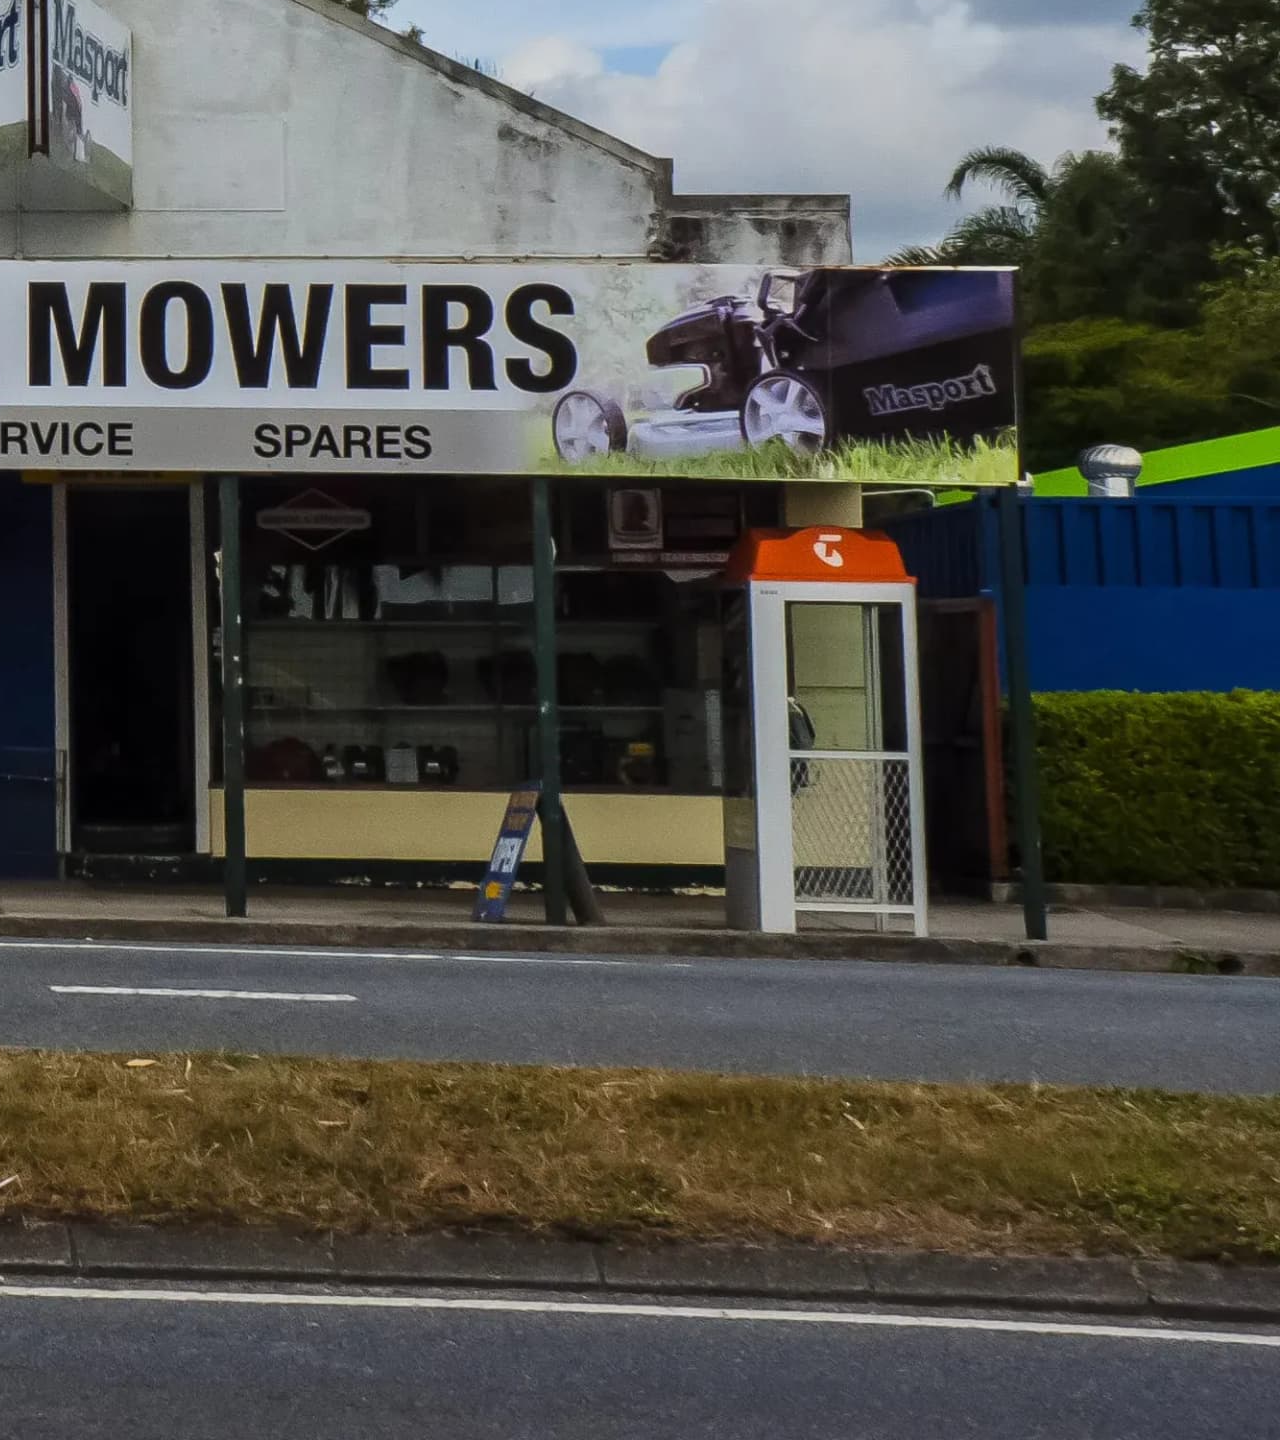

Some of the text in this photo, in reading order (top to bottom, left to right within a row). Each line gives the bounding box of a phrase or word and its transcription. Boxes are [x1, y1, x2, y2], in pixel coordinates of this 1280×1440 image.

[27, 280, 578, 393] MOWERS
[864, 364, 997, 416] Masport
[253, 423, 433, 458] SPARES
